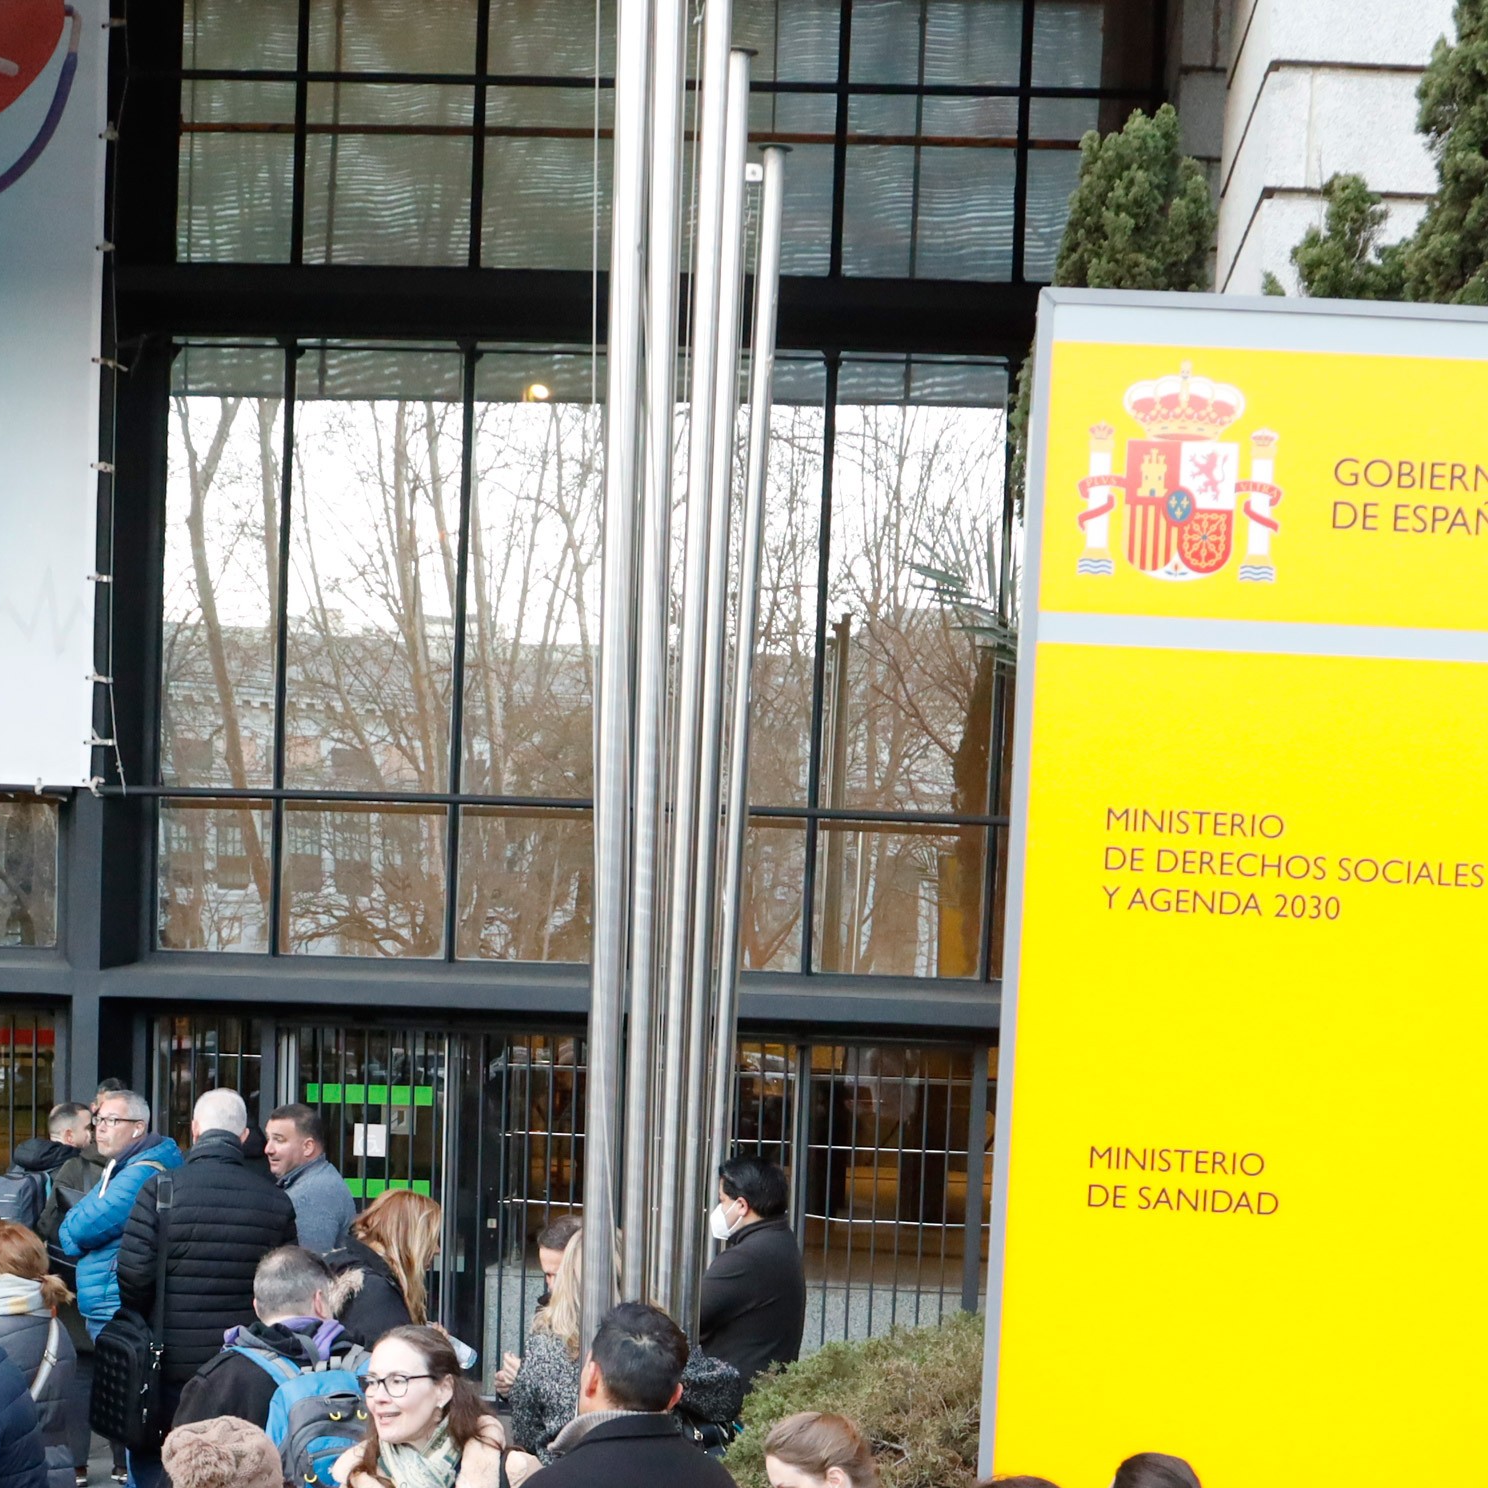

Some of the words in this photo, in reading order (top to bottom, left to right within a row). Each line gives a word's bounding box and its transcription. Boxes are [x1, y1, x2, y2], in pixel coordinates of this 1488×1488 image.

[1332, 501, 1378, 531] DE
[1106, 808, 1285, 840] MINISTERIO
[1104, 847, 1145, 872] DE
[1156, 849, 1327, 882] DERECHOS
[1338, 857, 1485, 889] SOCIALES
[1102, 886, 1120, 911] Y
[1126, 887, 1263, 917] AGENDA
[1274, 894, 1341, 921] 2030
[1089, 1146, 1265, 1177] MINISTERIO
[1087, 1184, 1128, 1210] DE
[1137, 1186, 1280, 1216] SANIDAD
